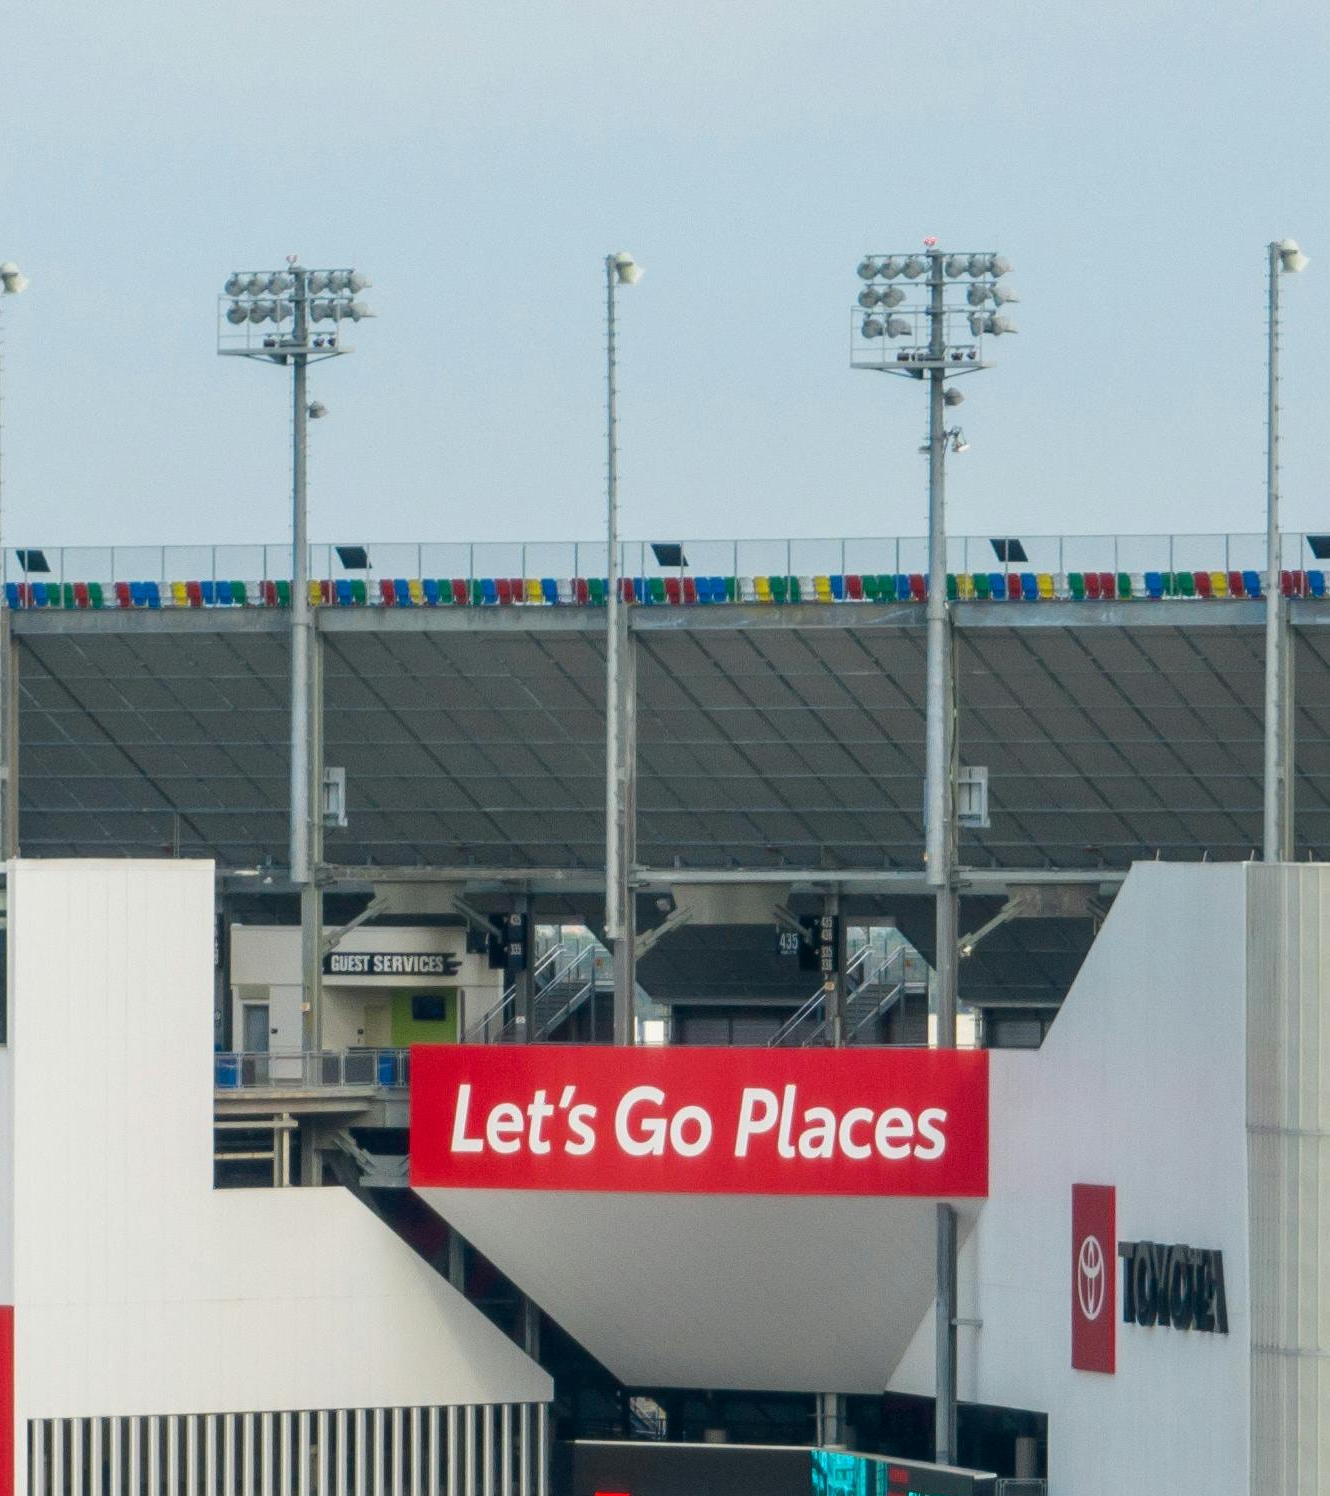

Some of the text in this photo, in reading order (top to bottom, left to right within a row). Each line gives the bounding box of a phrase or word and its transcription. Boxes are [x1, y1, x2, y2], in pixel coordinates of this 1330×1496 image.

[331, 956, 443, 974] GUEST SERVICES
[779, 933, 798, 949] 435
[450, 1083, 948, 1161] Let's Go Places
[1118, 1241, 1229, 1334] TOYOTA
